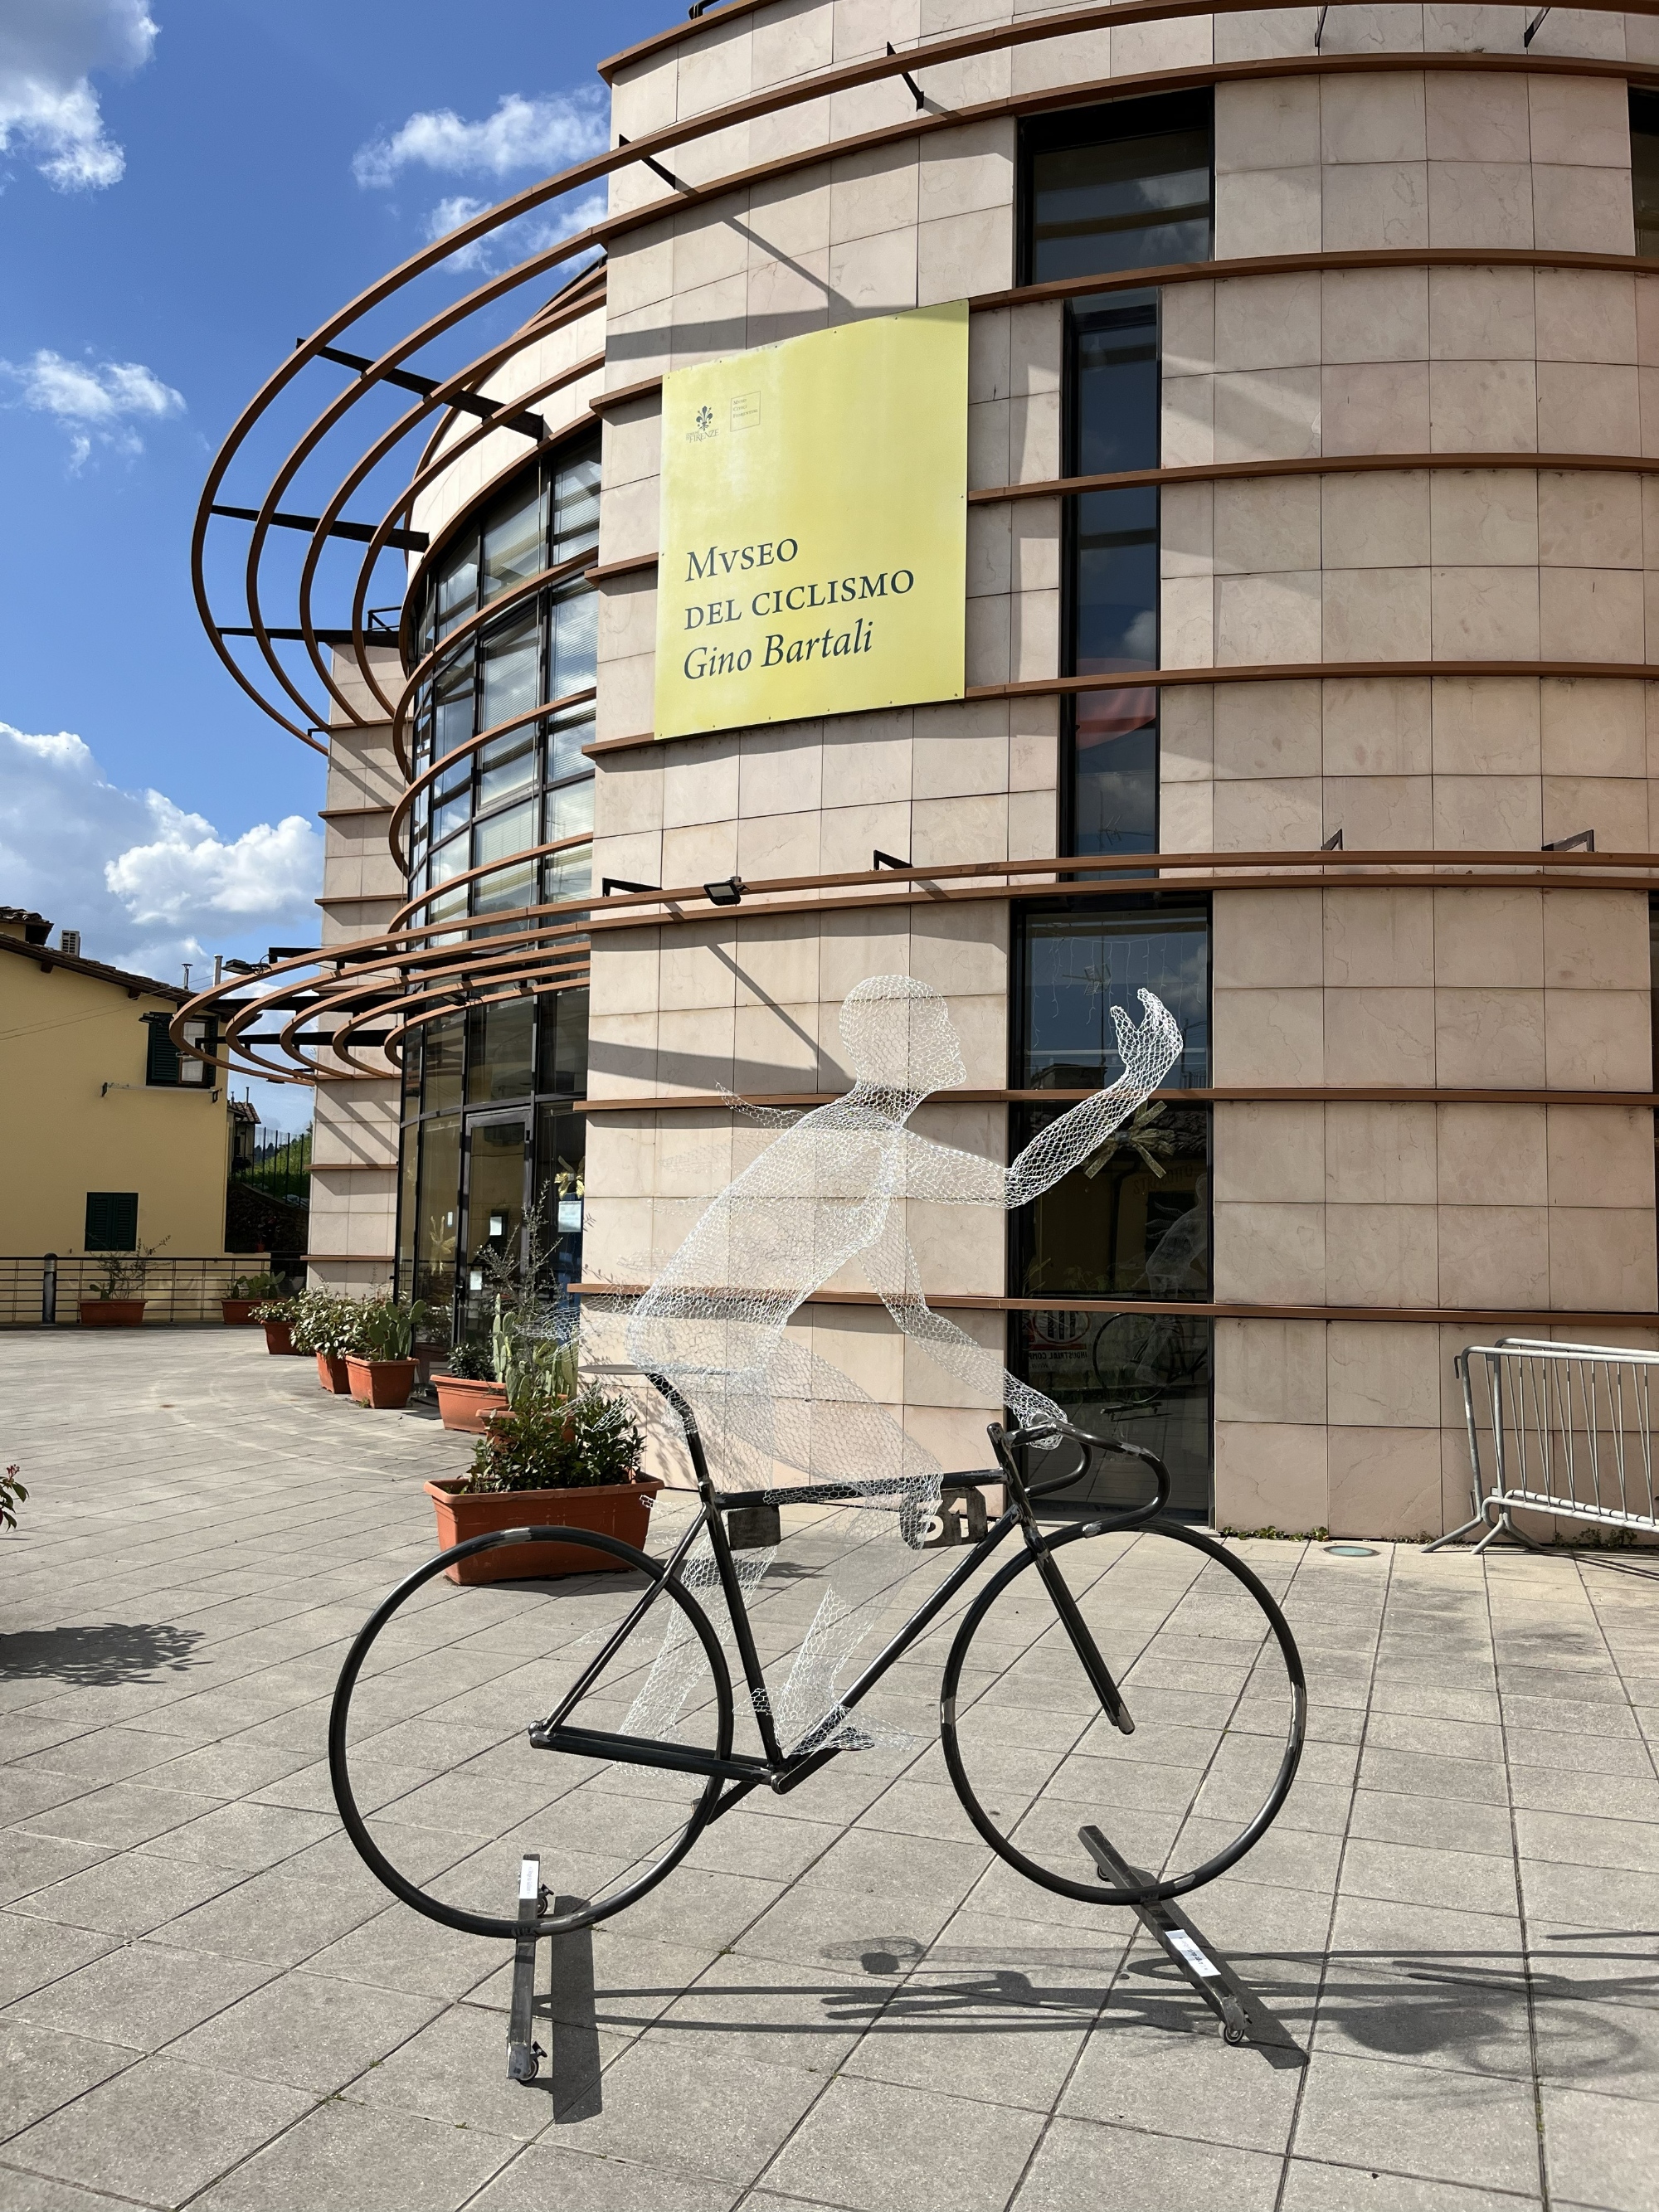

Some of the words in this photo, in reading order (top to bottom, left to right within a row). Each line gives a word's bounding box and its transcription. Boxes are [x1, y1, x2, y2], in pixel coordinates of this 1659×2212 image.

[689, 428, 720, 444] FIRENZE
[684, 599, 742, 630] DEL
[752, 569, 914, 616] CICLISMO
[684, 647, 752, 680] Gino
[761, 617, 873, 668] Bartali
